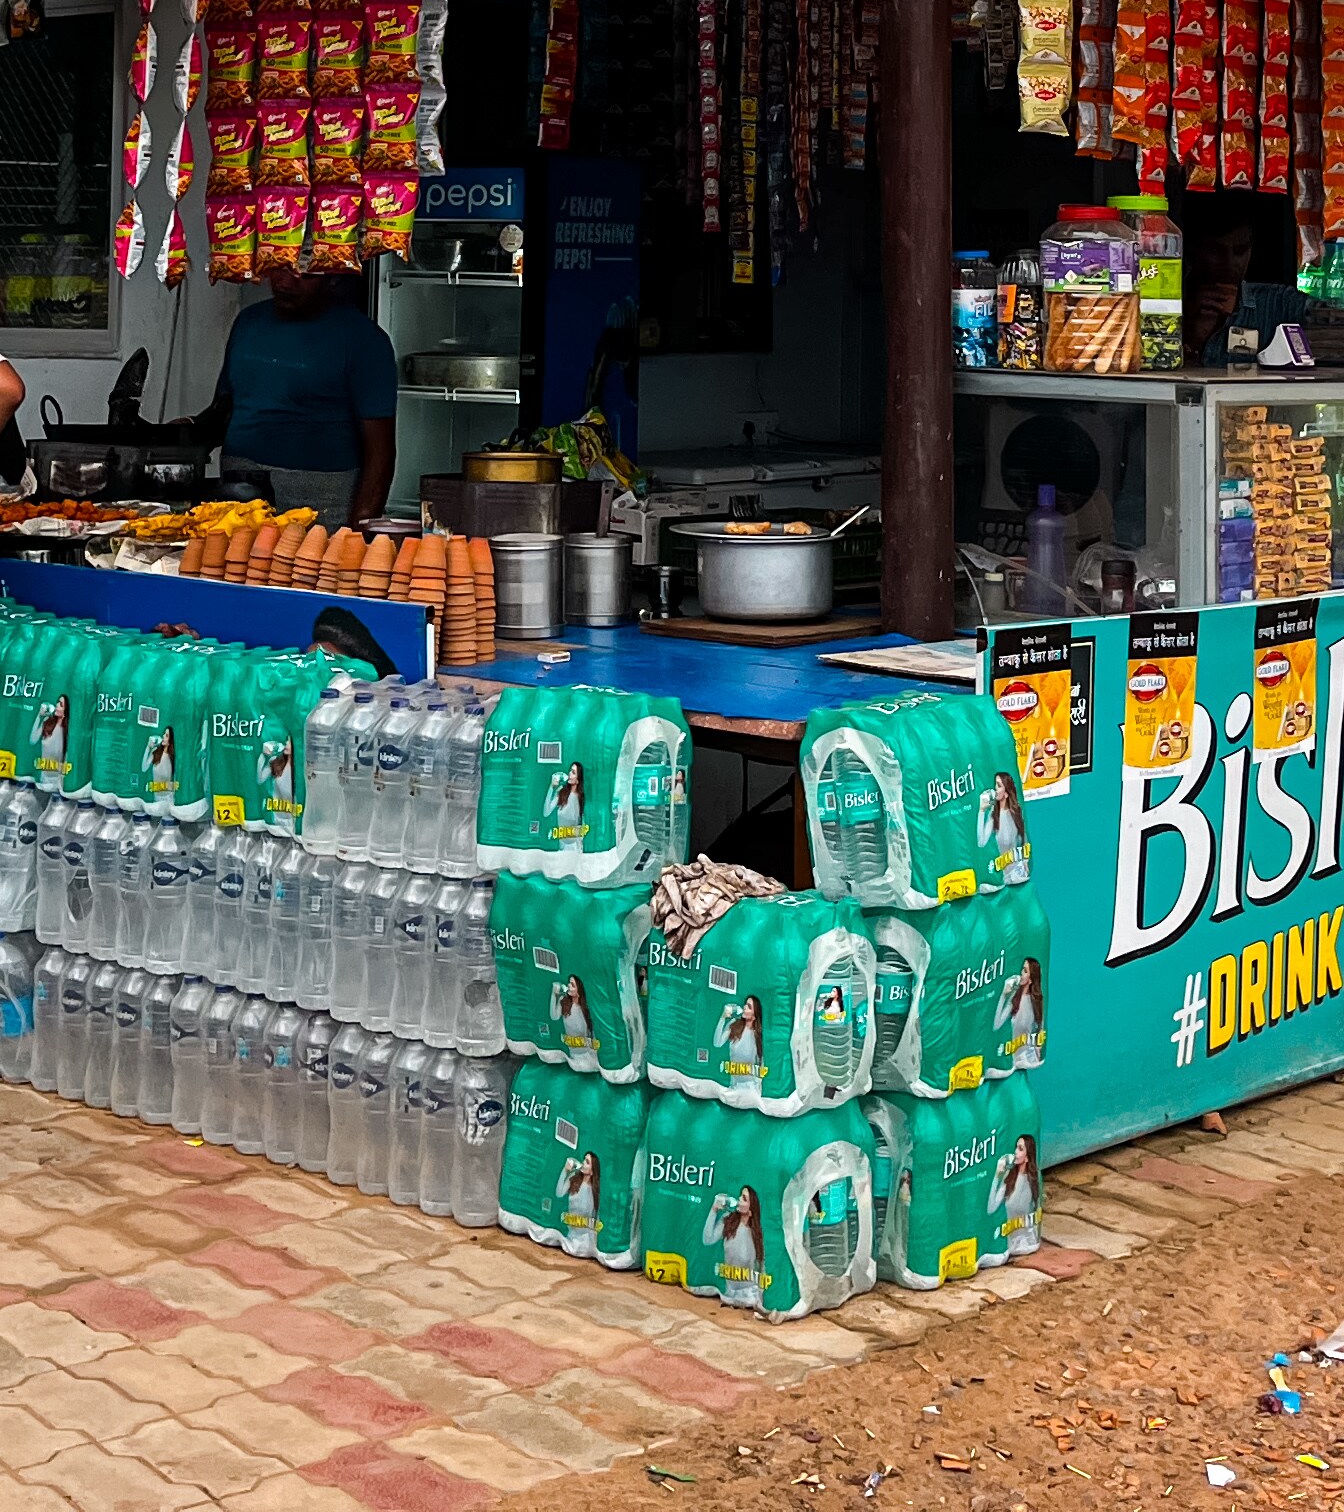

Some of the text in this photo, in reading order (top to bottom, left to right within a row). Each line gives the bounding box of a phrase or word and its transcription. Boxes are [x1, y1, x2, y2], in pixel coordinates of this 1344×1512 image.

[425, 178, 513, 214] pepsi
[1129, 675, 1165, 689] GOLD FLAKE
[996, 693, 1037, 708] GOLD FLAKE
[927, 763, 976, 812] Bisleri
[493, 928, 526, 952] isleri
[955, 949, 1006, 1001] Bisleri
[649, 1153, 716, 1188] Bisleri
[943, 1128, 998, 1181] Bisleri
